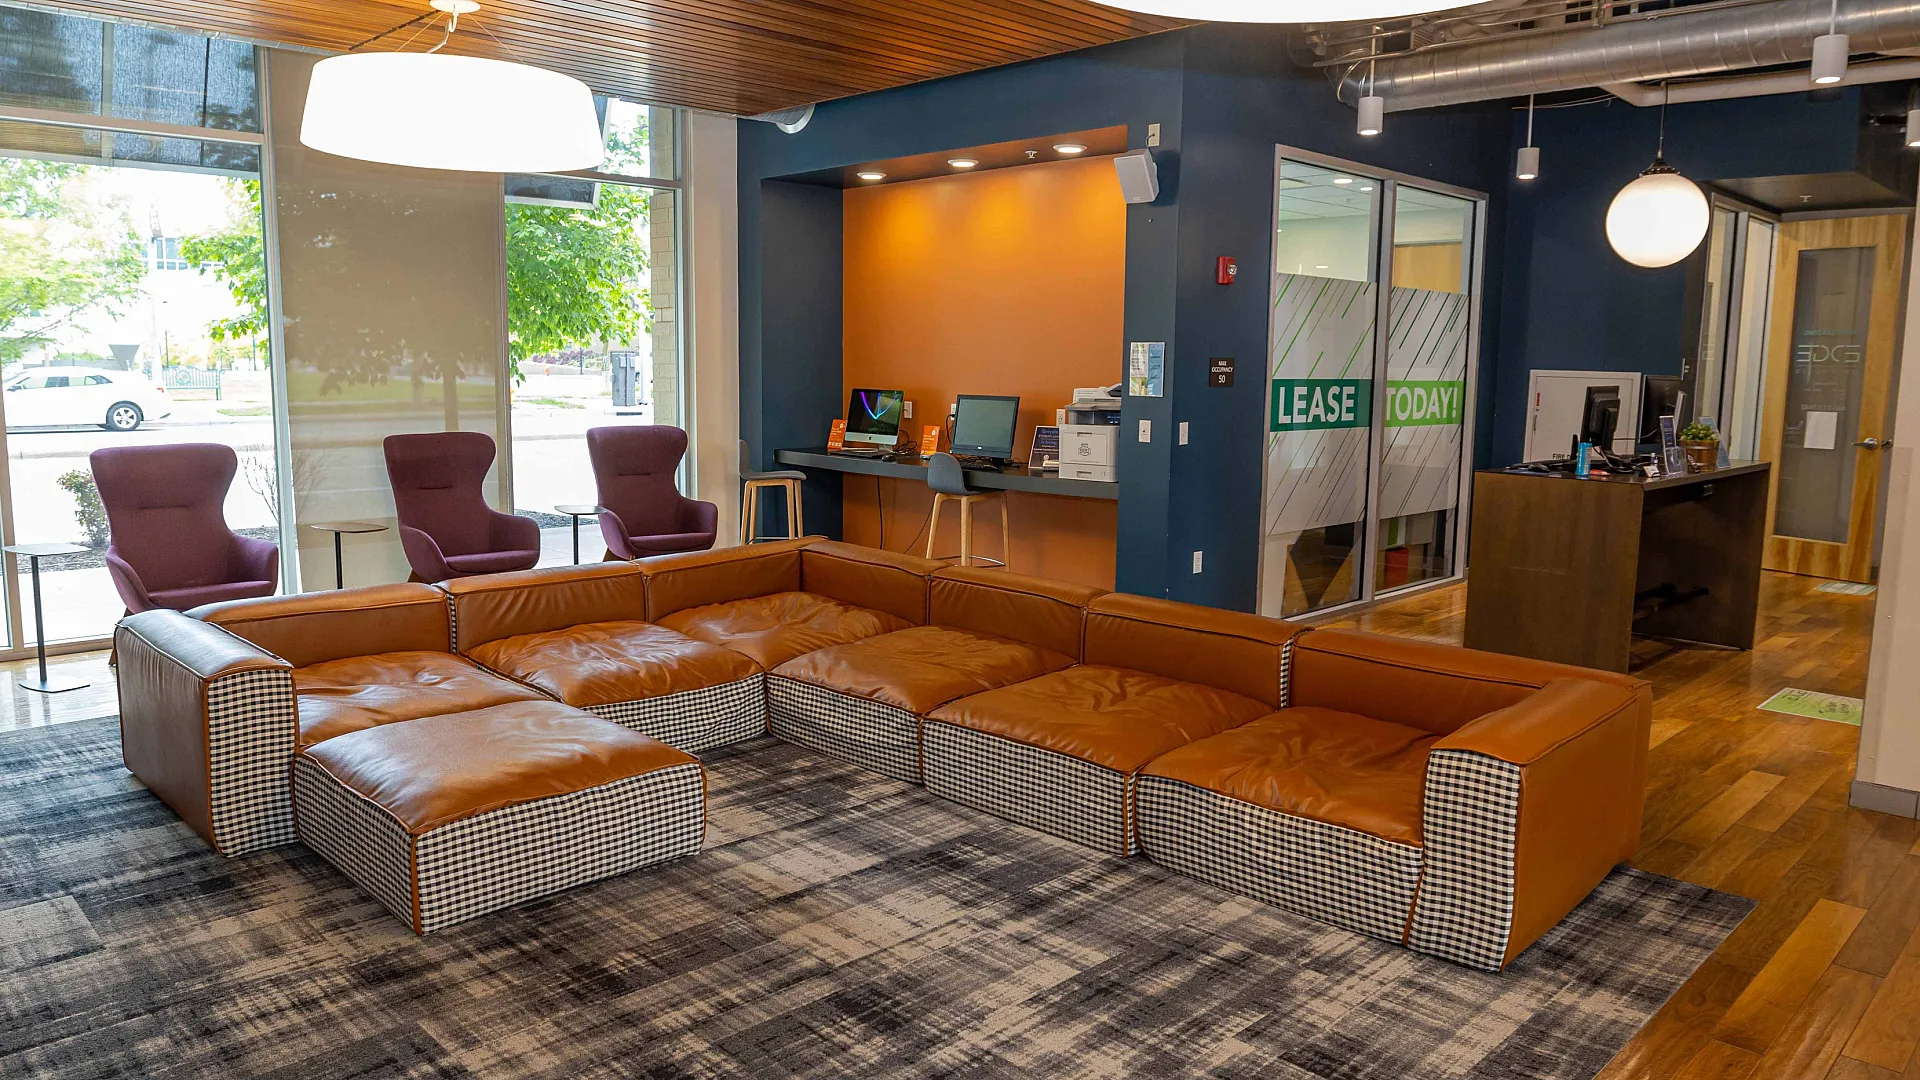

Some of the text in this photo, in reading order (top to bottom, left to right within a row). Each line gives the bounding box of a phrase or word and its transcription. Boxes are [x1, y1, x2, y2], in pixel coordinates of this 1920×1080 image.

[1218, 374, 1226, 383] 50
[1278, 385, 1458, 424] LEASE TODAY!
